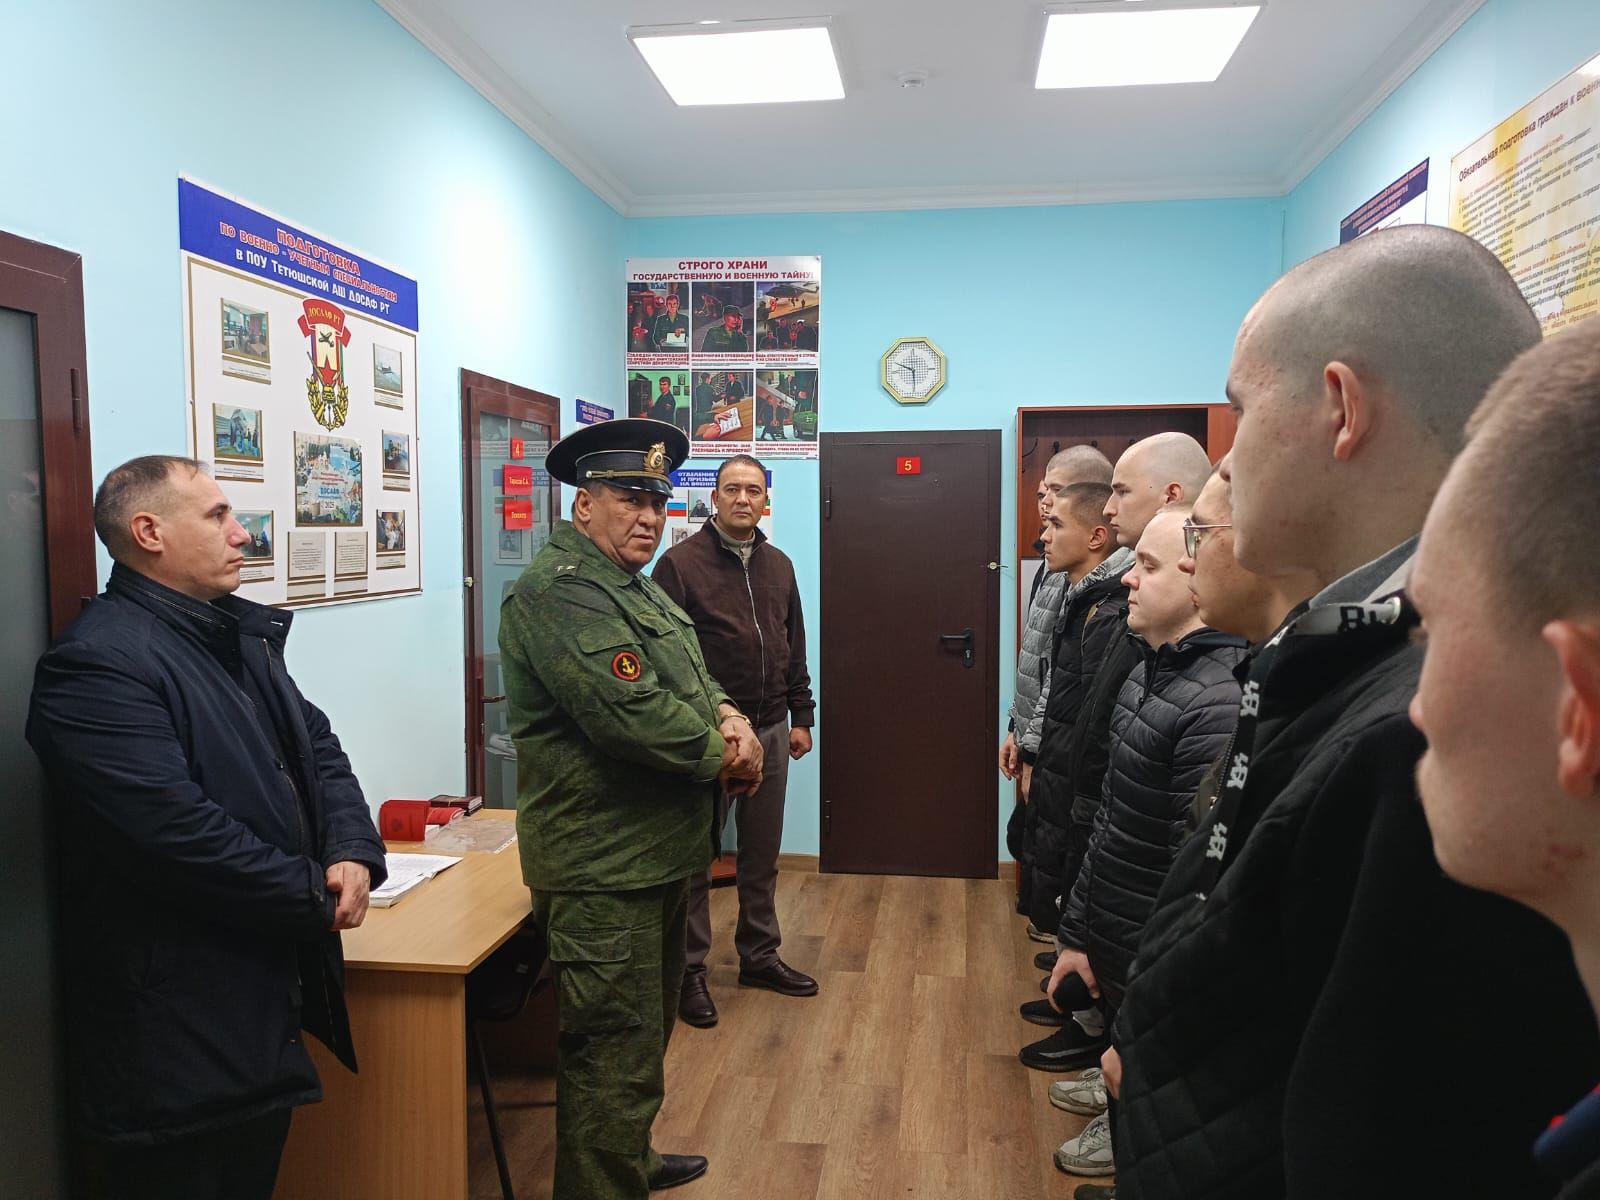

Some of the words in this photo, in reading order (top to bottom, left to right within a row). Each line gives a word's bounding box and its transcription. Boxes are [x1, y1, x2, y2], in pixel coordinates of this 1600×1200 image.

[1499, 121, 1536, 154] подготовка
[1538, 99, 1569, 128] граждан
[219, 221, 236, 238] ПО
[239, 229, 280, 255] ВОЕННО
[276, 228, 361, 276] ПОДГОТОВКА
[633, 273, 723, 281] ГОСУДАРСТВЕННУЮ
[678, 261, 724, 270] СТРОГО
[727, 260, 768, 270] ХРАНИ
[235, 248, 243, 261] В
[246, 250, 267, 269] ПОУ
[332, 283, 346, 298] АШ
[380, 302, 390, 315] РТ
[515, 442, 520, 457] 4
[904, 460, 912, 471] 5
